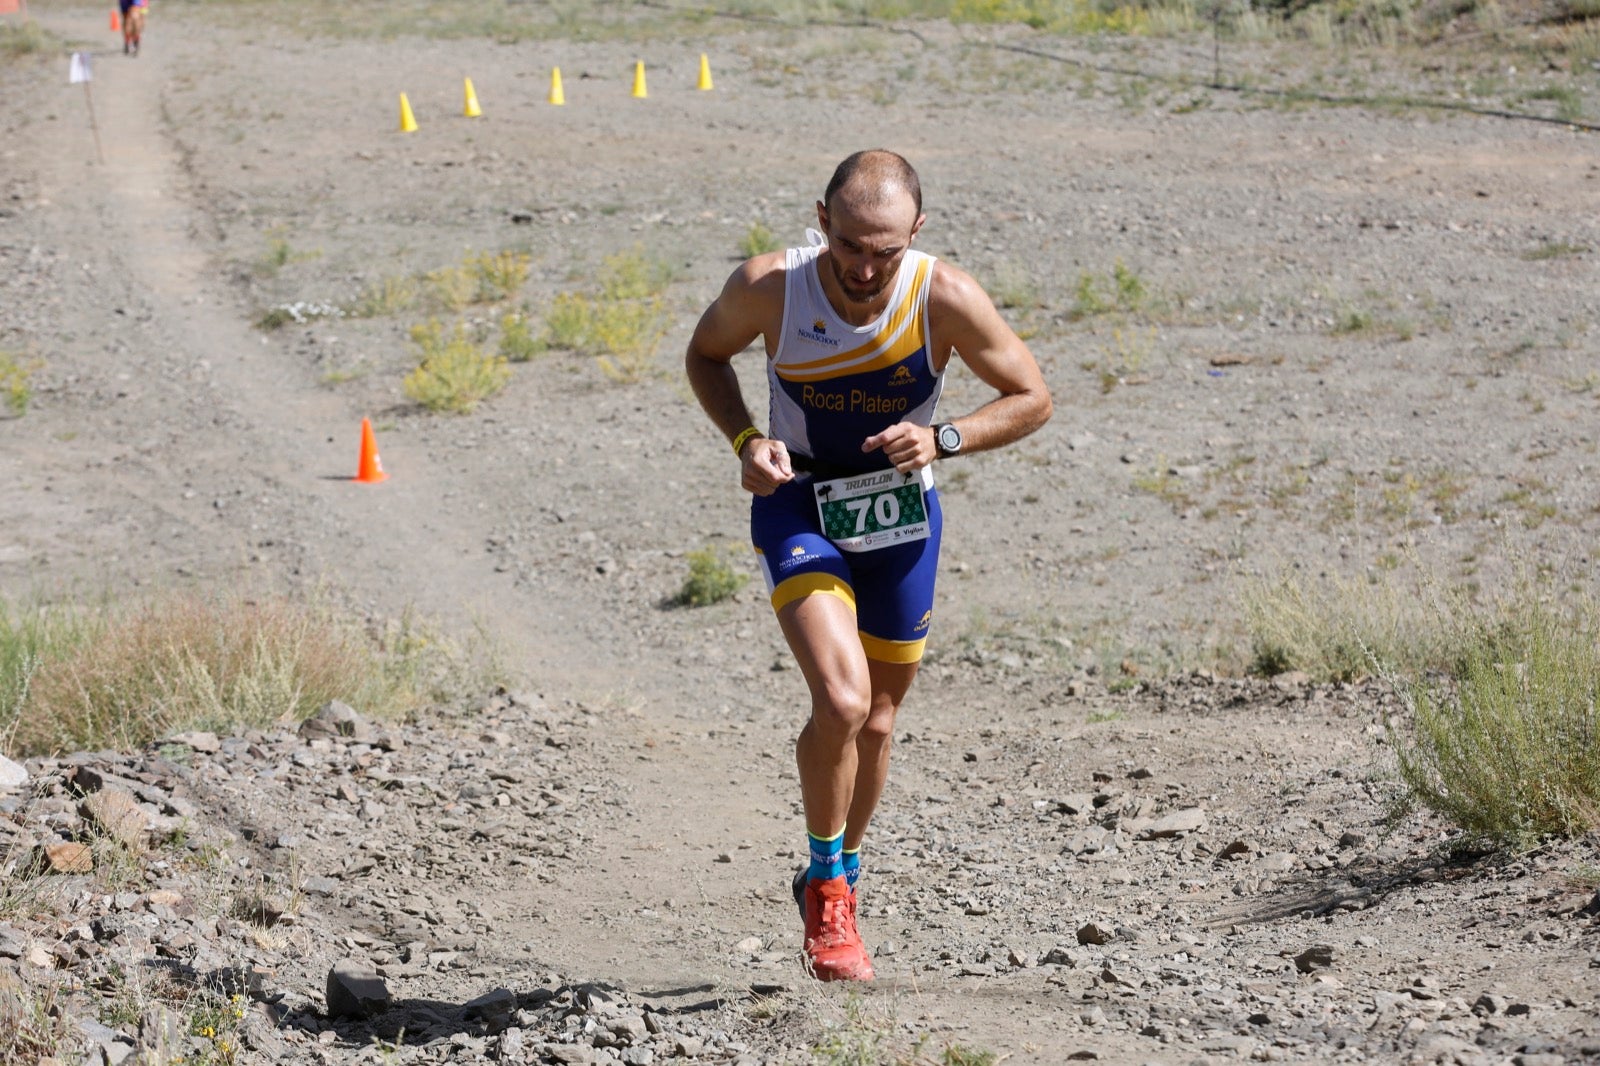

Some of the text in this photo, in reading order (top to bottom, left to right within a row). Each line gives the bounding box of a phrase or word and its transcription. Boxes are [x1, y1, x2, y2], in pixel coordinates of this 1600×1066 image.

[802, 384, 908, 414] Roca Platero
[844, 472, 894, 491] TRIATLON
[845, 492, 900, 533] 70
